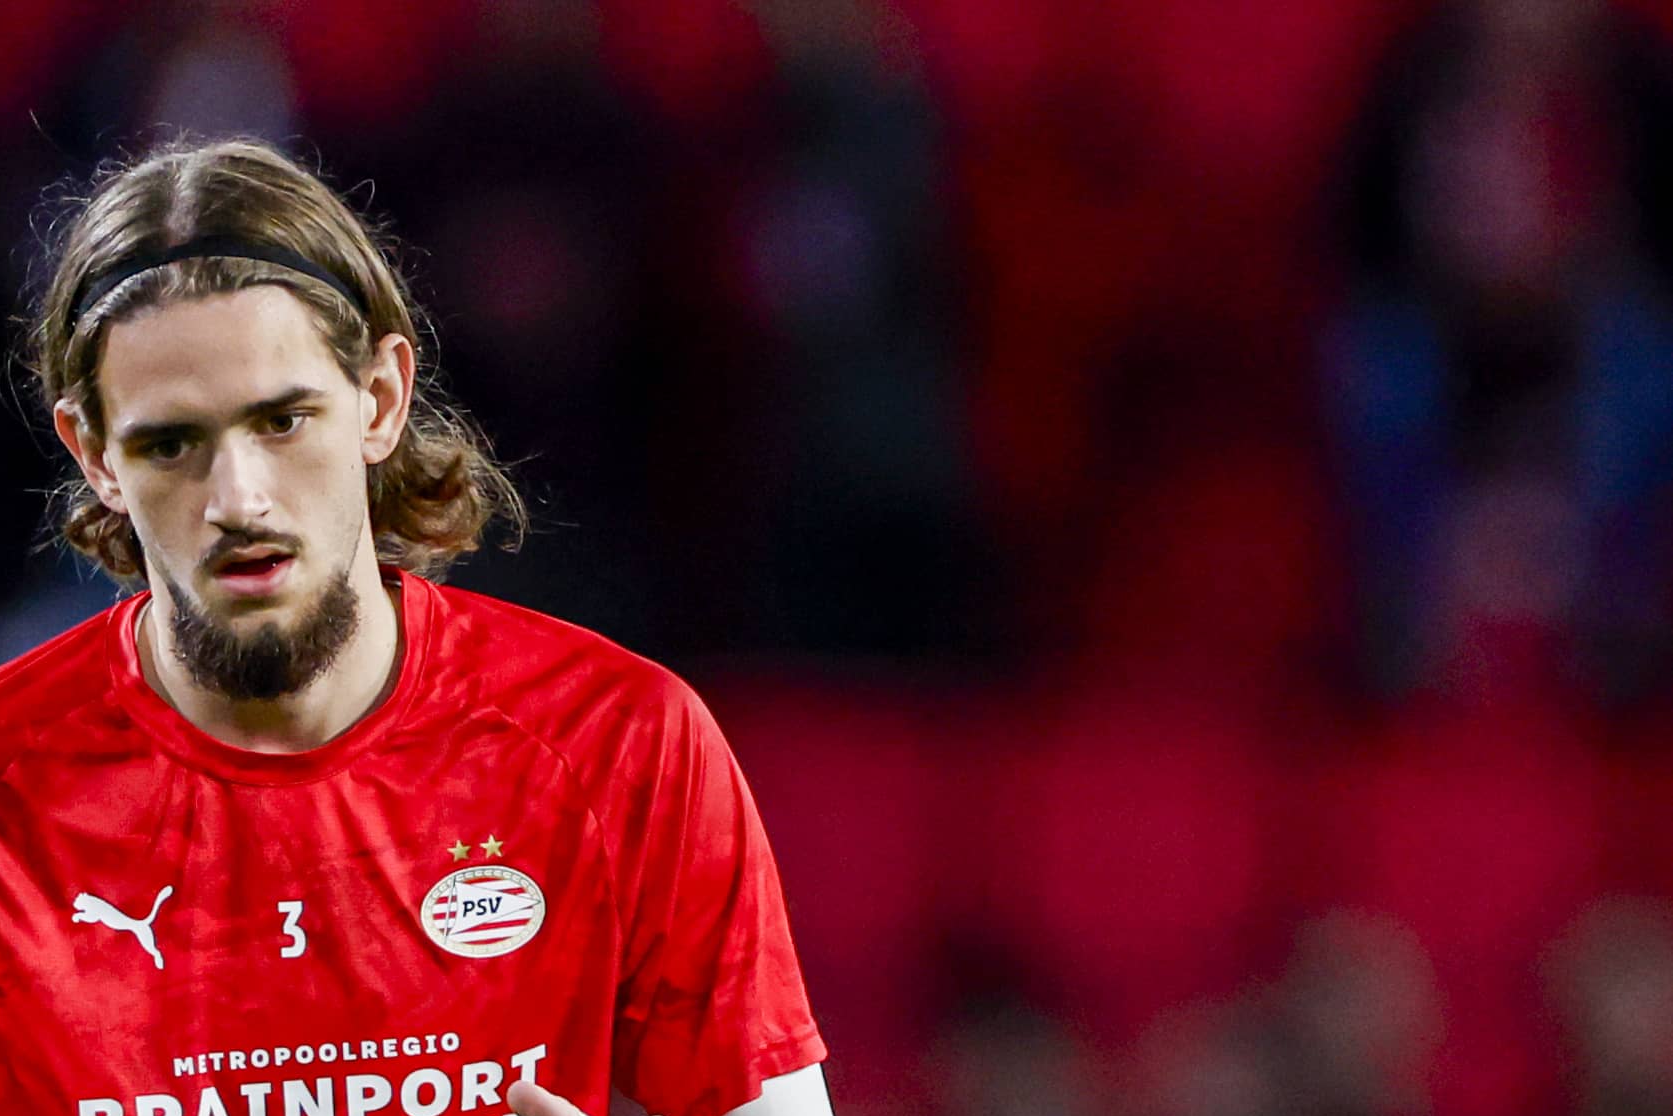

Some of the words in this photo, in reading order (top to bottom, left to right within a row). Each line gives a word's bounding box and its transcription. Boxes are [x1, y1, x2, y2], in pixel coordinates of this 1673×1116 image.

[277, 900, 307, 958] 3
[462, 896, 503, 918] PSV
[172, 1031, 460, 1077] METROPOOLREGIO
